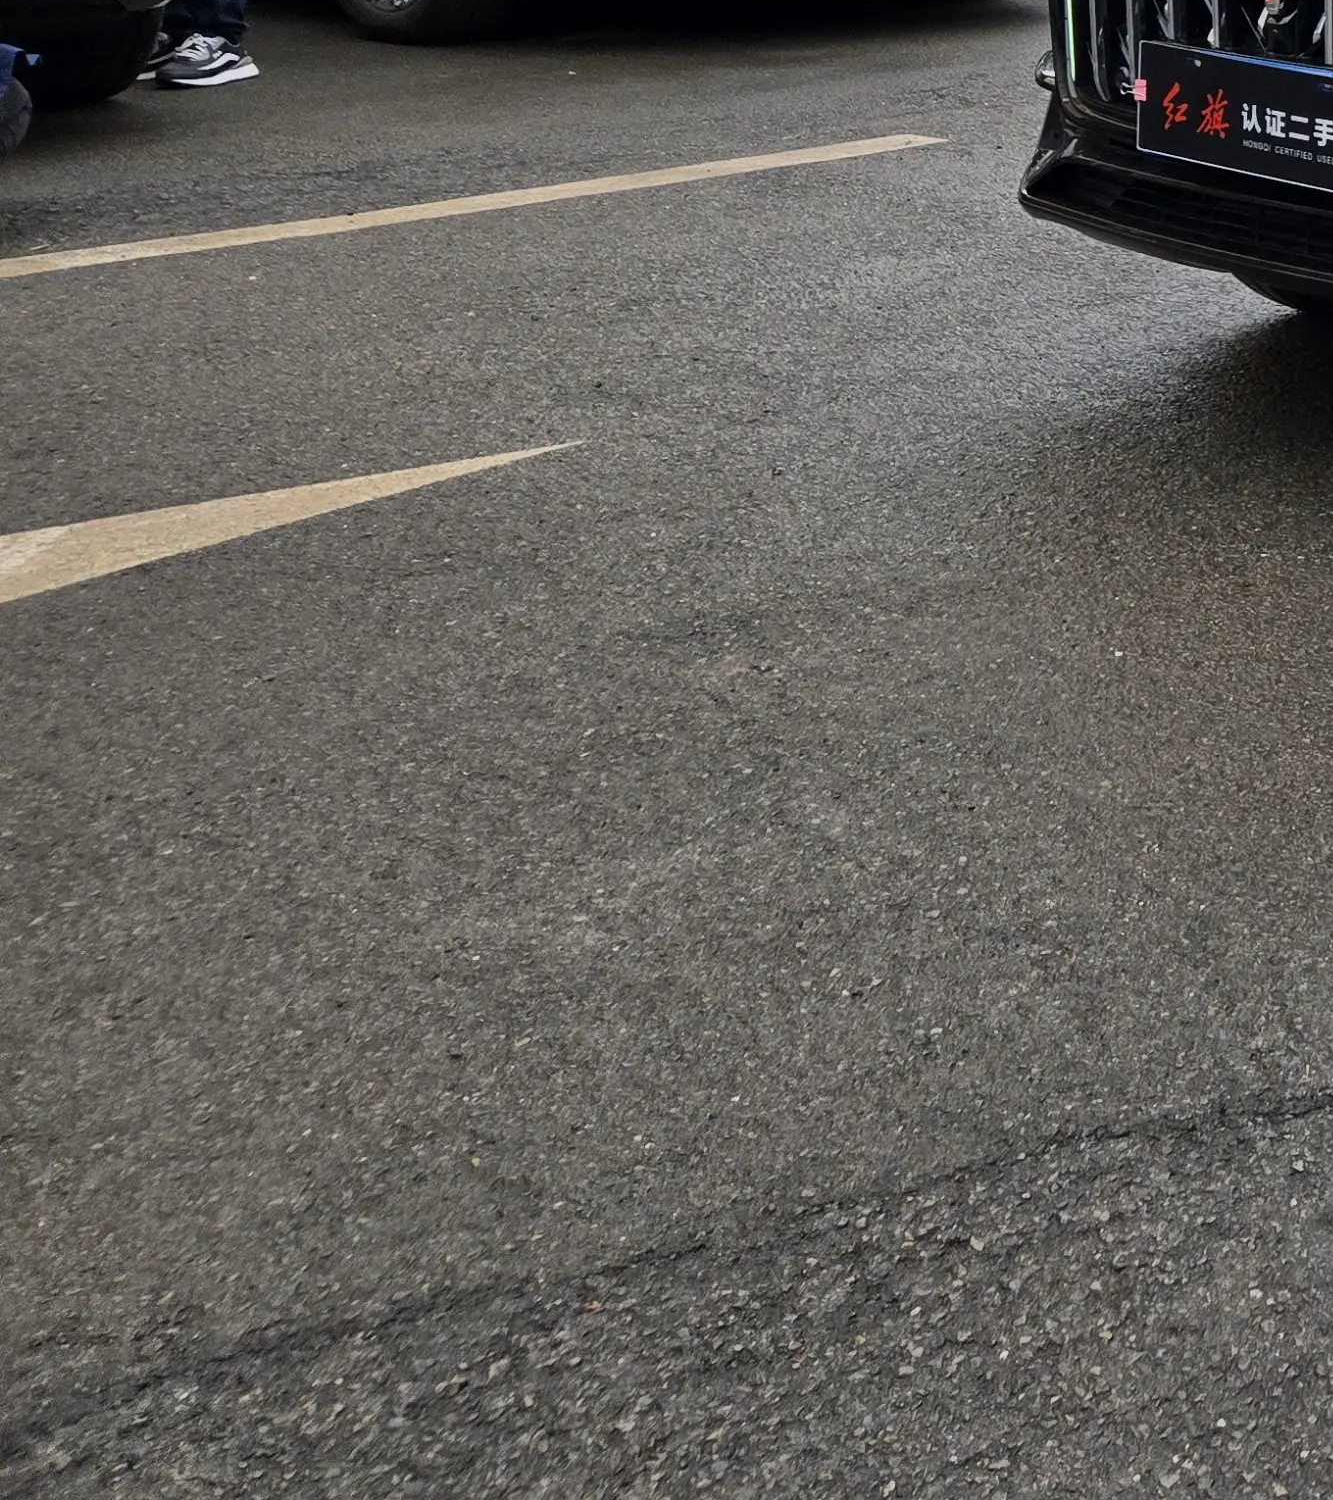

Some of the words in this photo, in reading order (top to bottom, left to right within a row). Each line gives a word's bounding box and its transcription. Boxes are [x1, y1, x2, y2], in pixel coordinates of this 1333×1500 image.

[1163, 81, 1231, 139] 红旗
[1243, 139, 1272, 152] HONGQI
[1274, 145, 1313, 161] CERTIFIED
